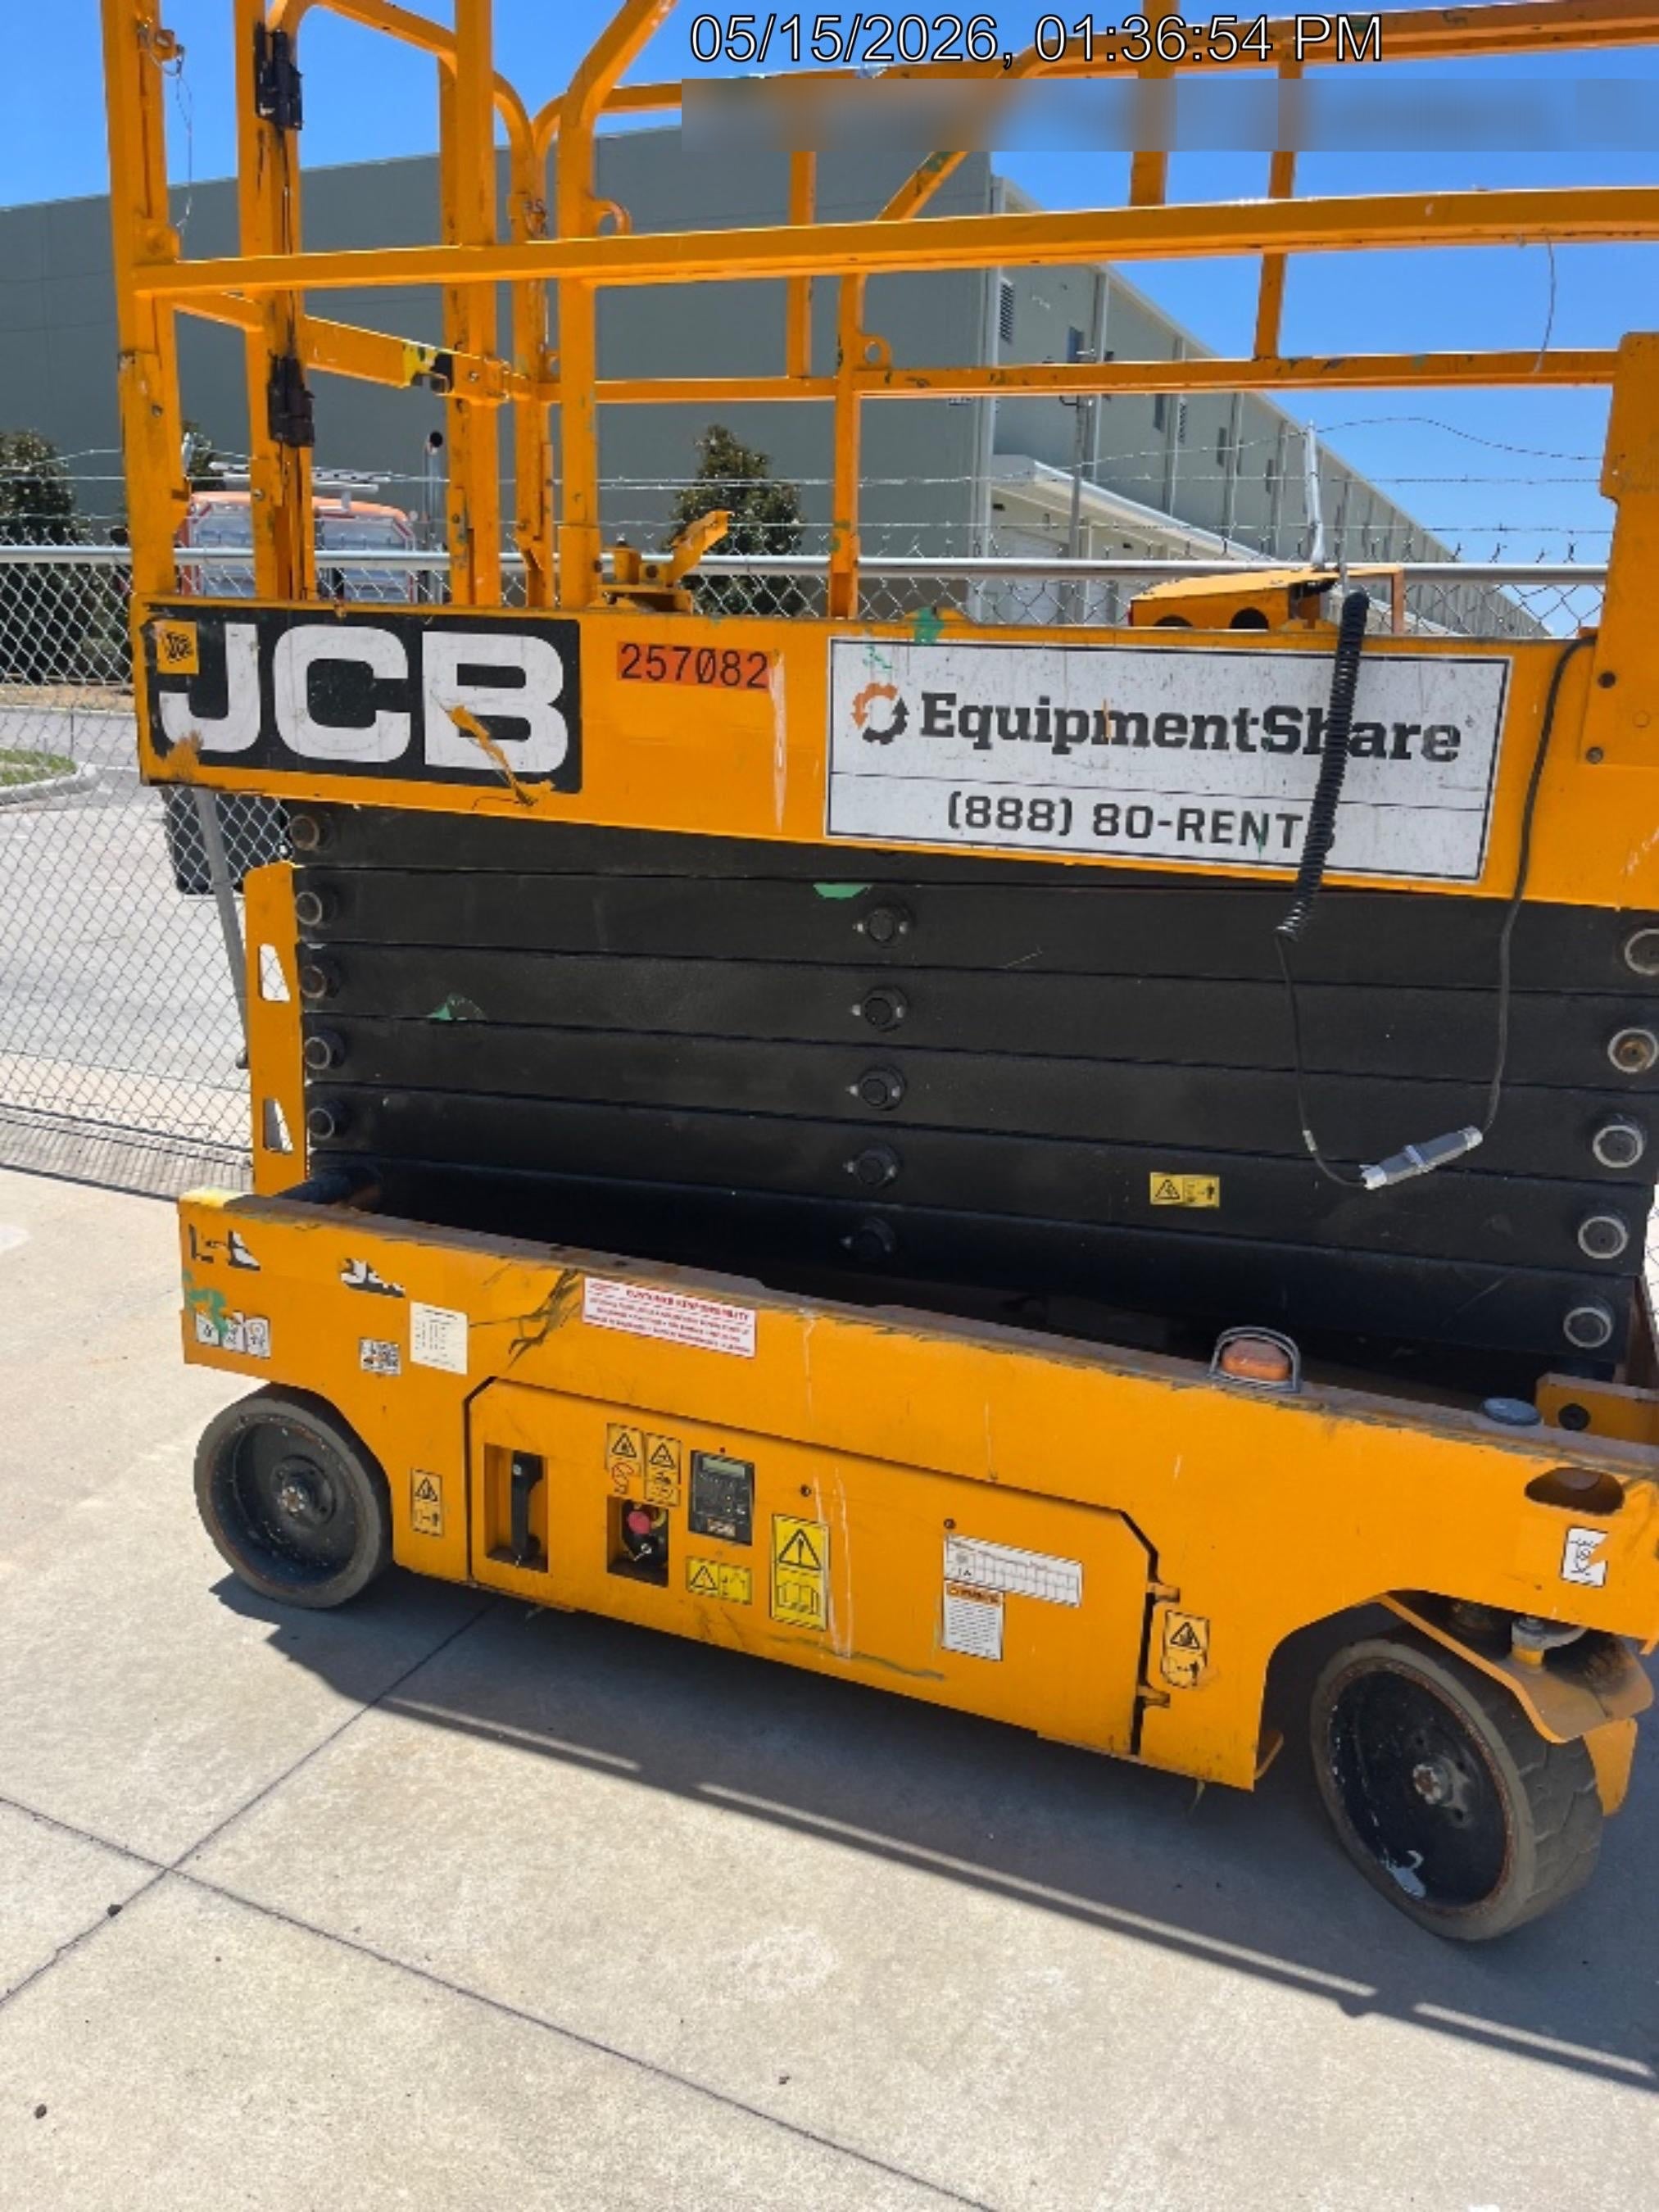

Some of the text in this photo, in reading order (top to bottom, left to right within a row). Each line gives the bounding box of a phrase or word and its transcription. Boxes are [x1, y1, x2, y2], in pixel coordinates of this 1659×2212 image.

[159, 623, 569, 773] JCB
[620, 643, 768, 689] 257082
[920, 691, 1461, 763] EquipmentShare
[948, 791, 1335, 853] (888) 80-RENT
